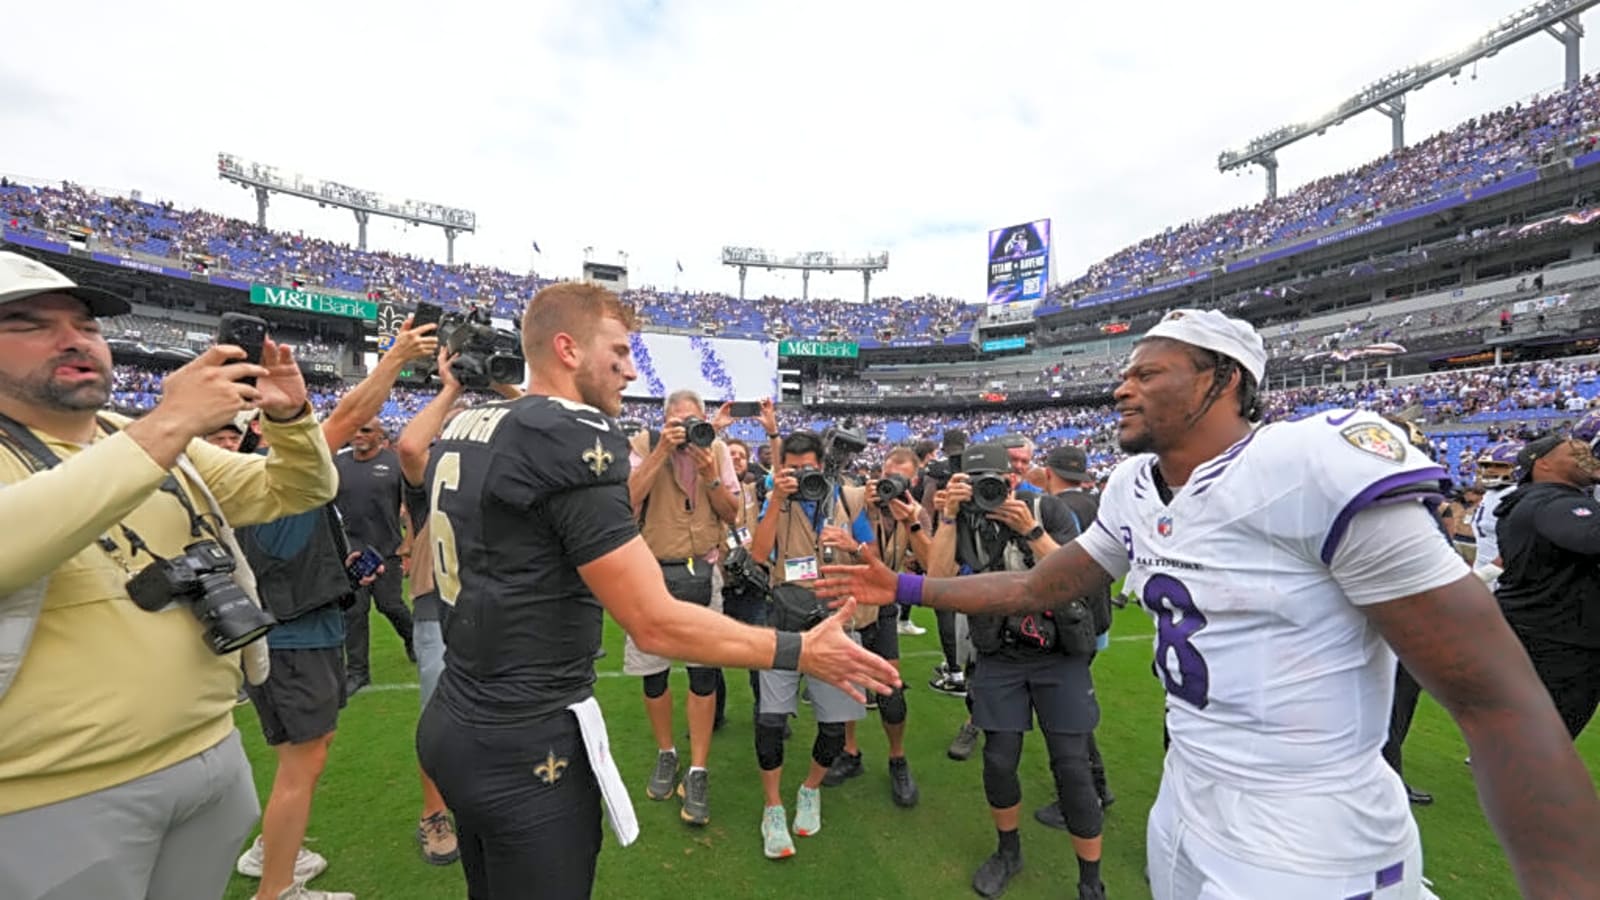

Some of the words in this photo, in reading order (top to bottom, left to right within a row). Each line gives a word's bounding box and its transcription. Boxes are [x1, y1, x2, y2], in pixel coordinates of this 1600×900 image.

[264, 287, 318, 310] M&T
[319, 297, 366, 317] Bank
[788, 342, 819, 356] M&T
[820, 343, 853, 357] Bank
[430, 452, 462, 607] 6
[1143, 572, 1209, 710] 8
